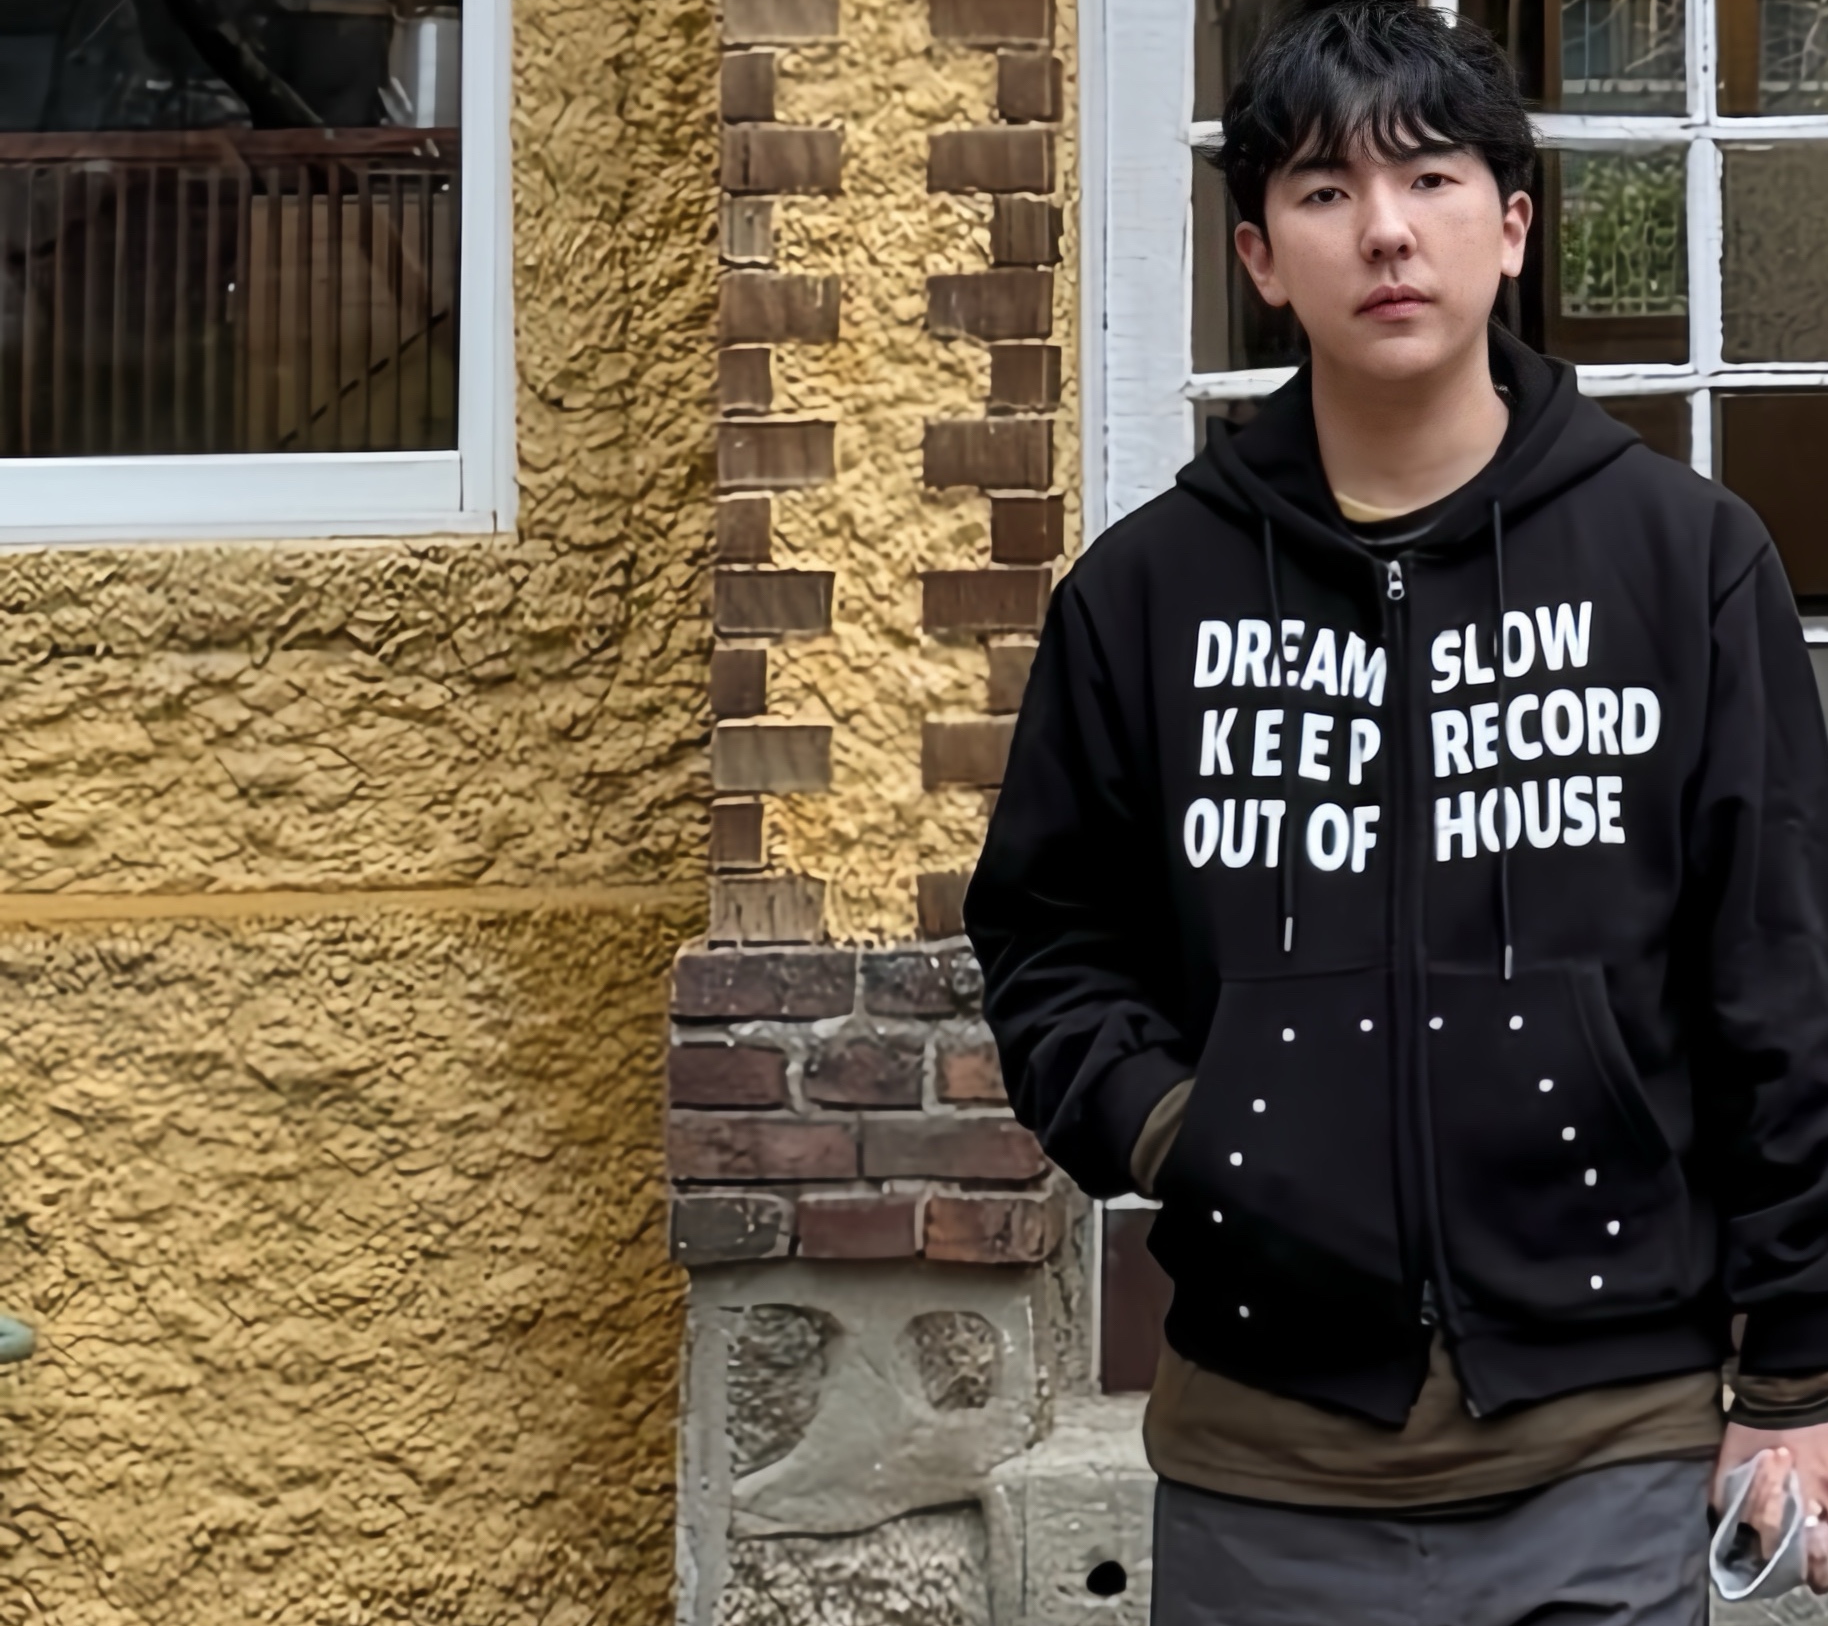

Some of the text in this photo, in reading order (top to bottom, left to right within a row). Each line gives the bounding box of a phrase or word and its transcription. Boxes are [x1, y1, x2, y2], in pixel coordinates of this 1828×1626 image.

[1194, 601, 1592, 706] DREAM SLOW
[1199, 687, 1661, 785] KEEP RECORD
[1183, 775, 1626, 873] OUT OF HOUSE
